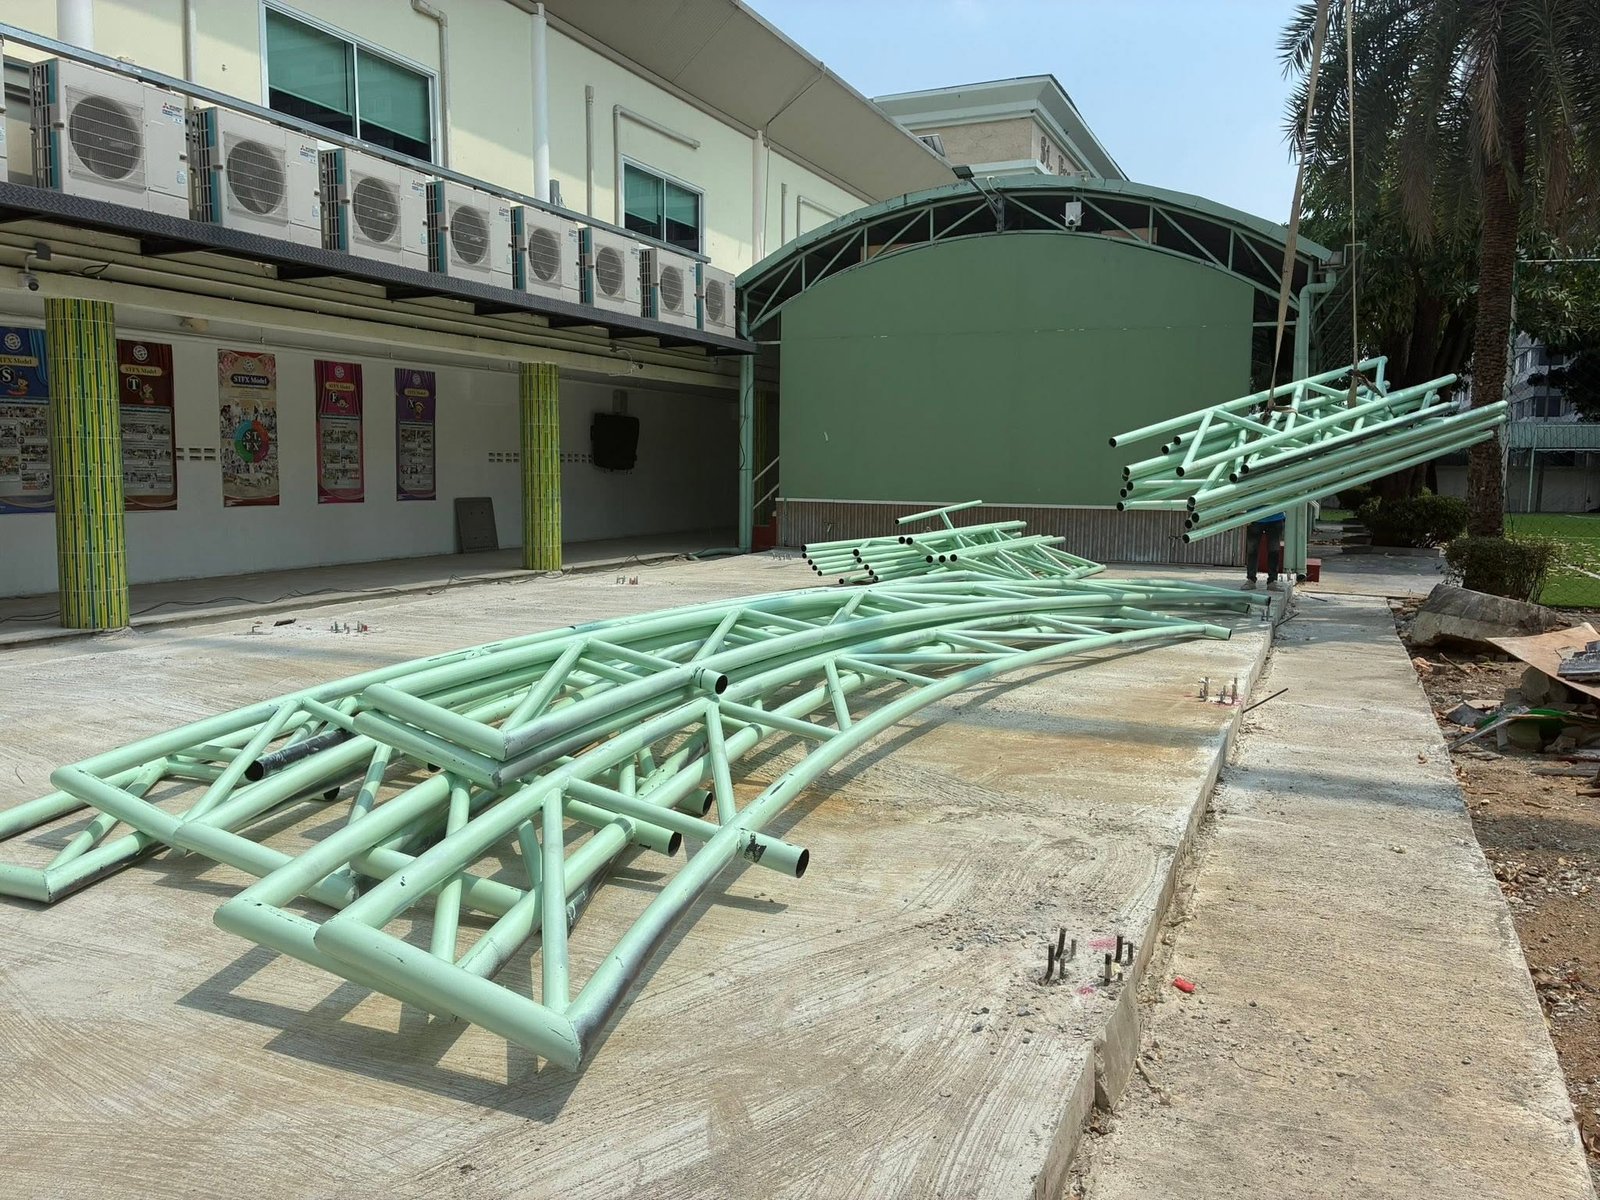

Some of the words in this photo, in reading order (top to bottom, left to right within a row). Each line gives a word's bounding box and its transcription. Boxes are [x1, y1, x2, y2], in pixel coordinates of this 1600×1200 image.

[13, 357, 32, 365] Model
[2, 368, 12, 382] S
[233, 375, 250, 383] STFX
[250, 376, 268, 385] Model
[130, 378, 139, 390] T
